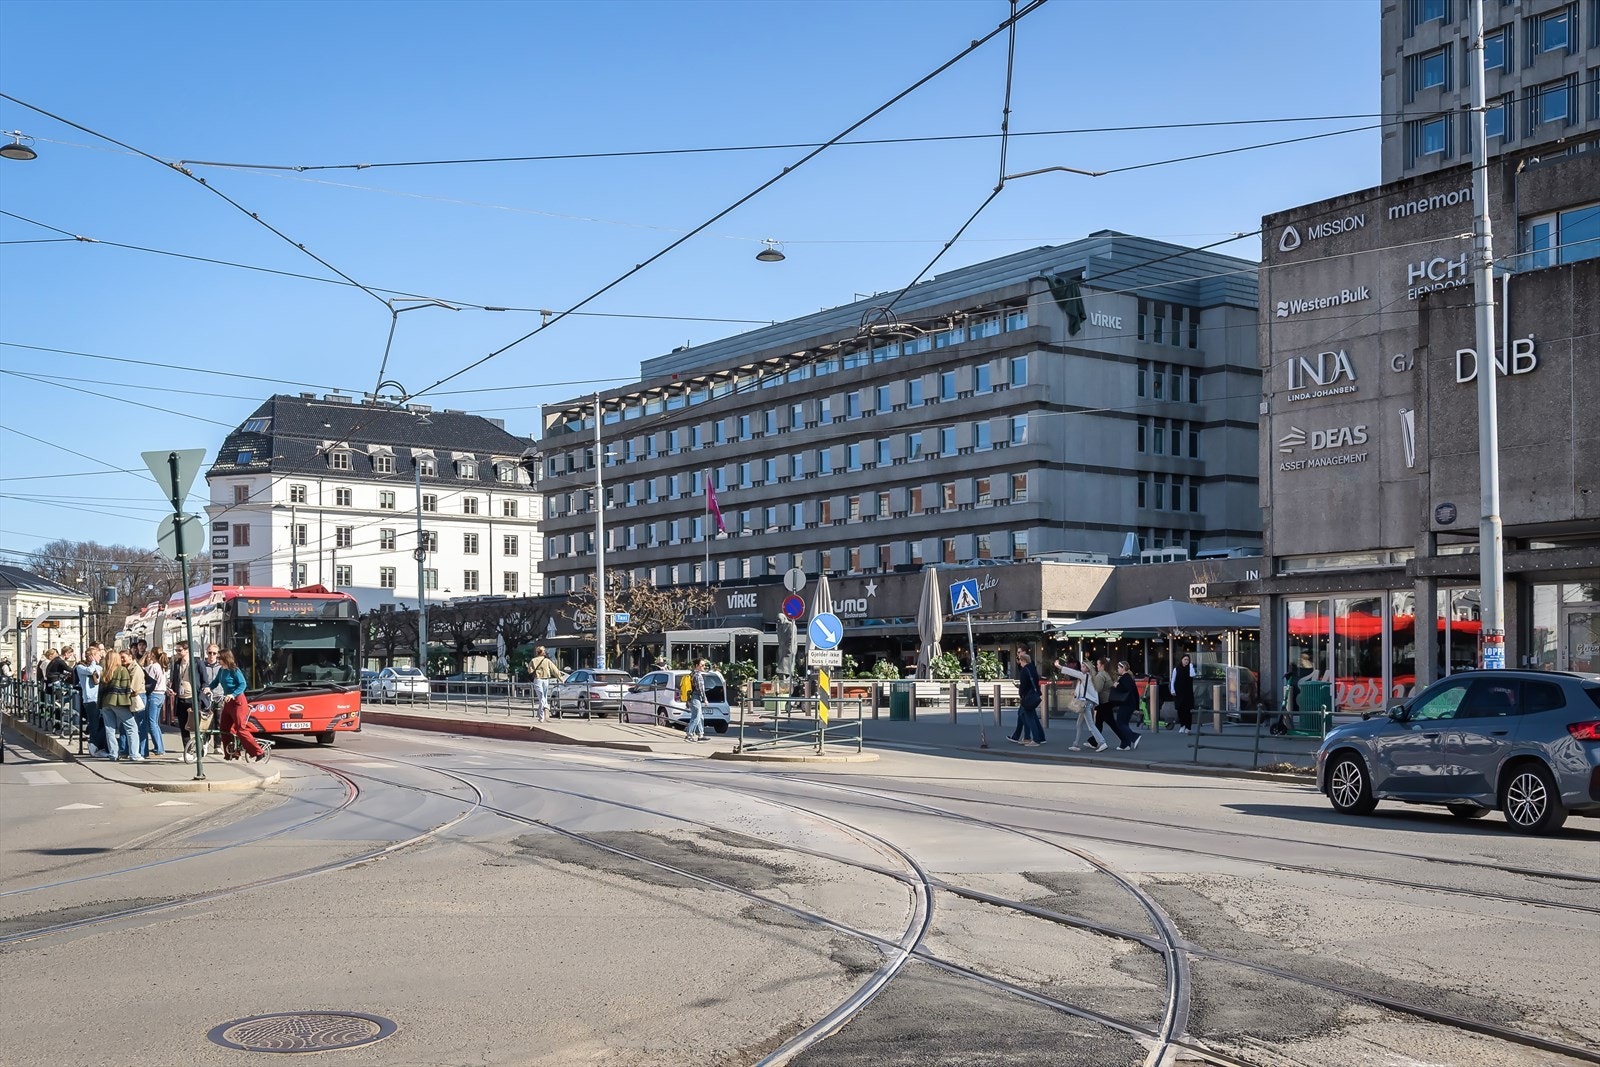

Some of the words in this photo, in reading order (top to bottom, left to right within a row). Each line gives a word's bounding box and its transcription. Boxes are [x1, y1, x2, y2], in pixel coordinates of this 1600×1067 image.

[1308, 213, 1365, 241] MISSION
[1408, 252, 1466, 286] HCH
[1456, 273, 1537, 384] DNB
[1287, 392, 1311, 402] LINDA
[1312, 385, 1356, 399] JOHANSEN
[1311, 425, 1368, 451] DEAS
[1279, 459, 1306, 471] ASSET
[1307, 452, 1368, 467] MANAGEMENT
[1190, 586, 1206, 596] 100
[247, 599, 261, 614] 31
